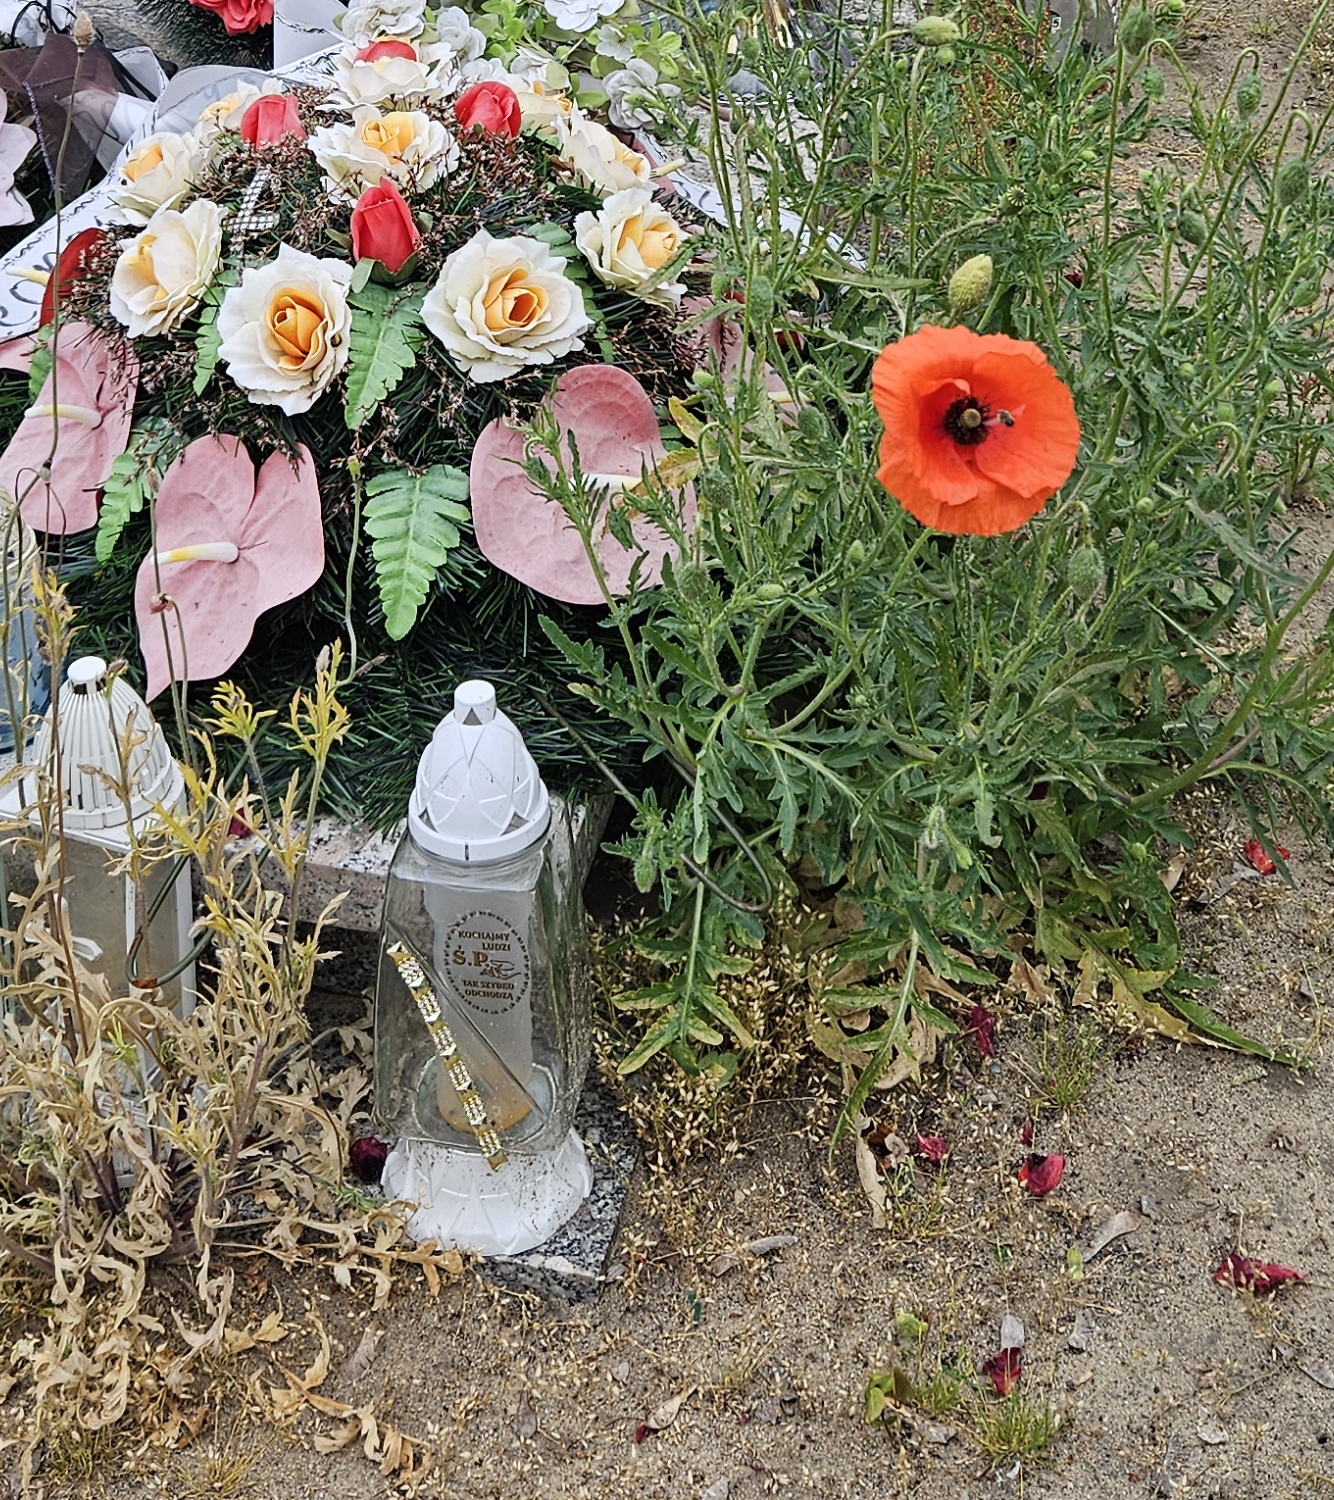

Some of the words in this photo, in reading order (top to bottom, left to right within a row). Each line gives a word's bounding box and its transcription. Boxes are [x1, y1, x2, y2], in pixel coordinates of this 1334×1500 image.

[458, 931, 510, 941] KOCHAJMY
[482, 942, 511, 952] LUDZI
[452, 945, 490, 967] Ś.P.
[461, 979, 479, 988] TAK
[480, 981, 516, 990] SZYBKO
[464, 988, 514, 1001] ODCHODZĄ
